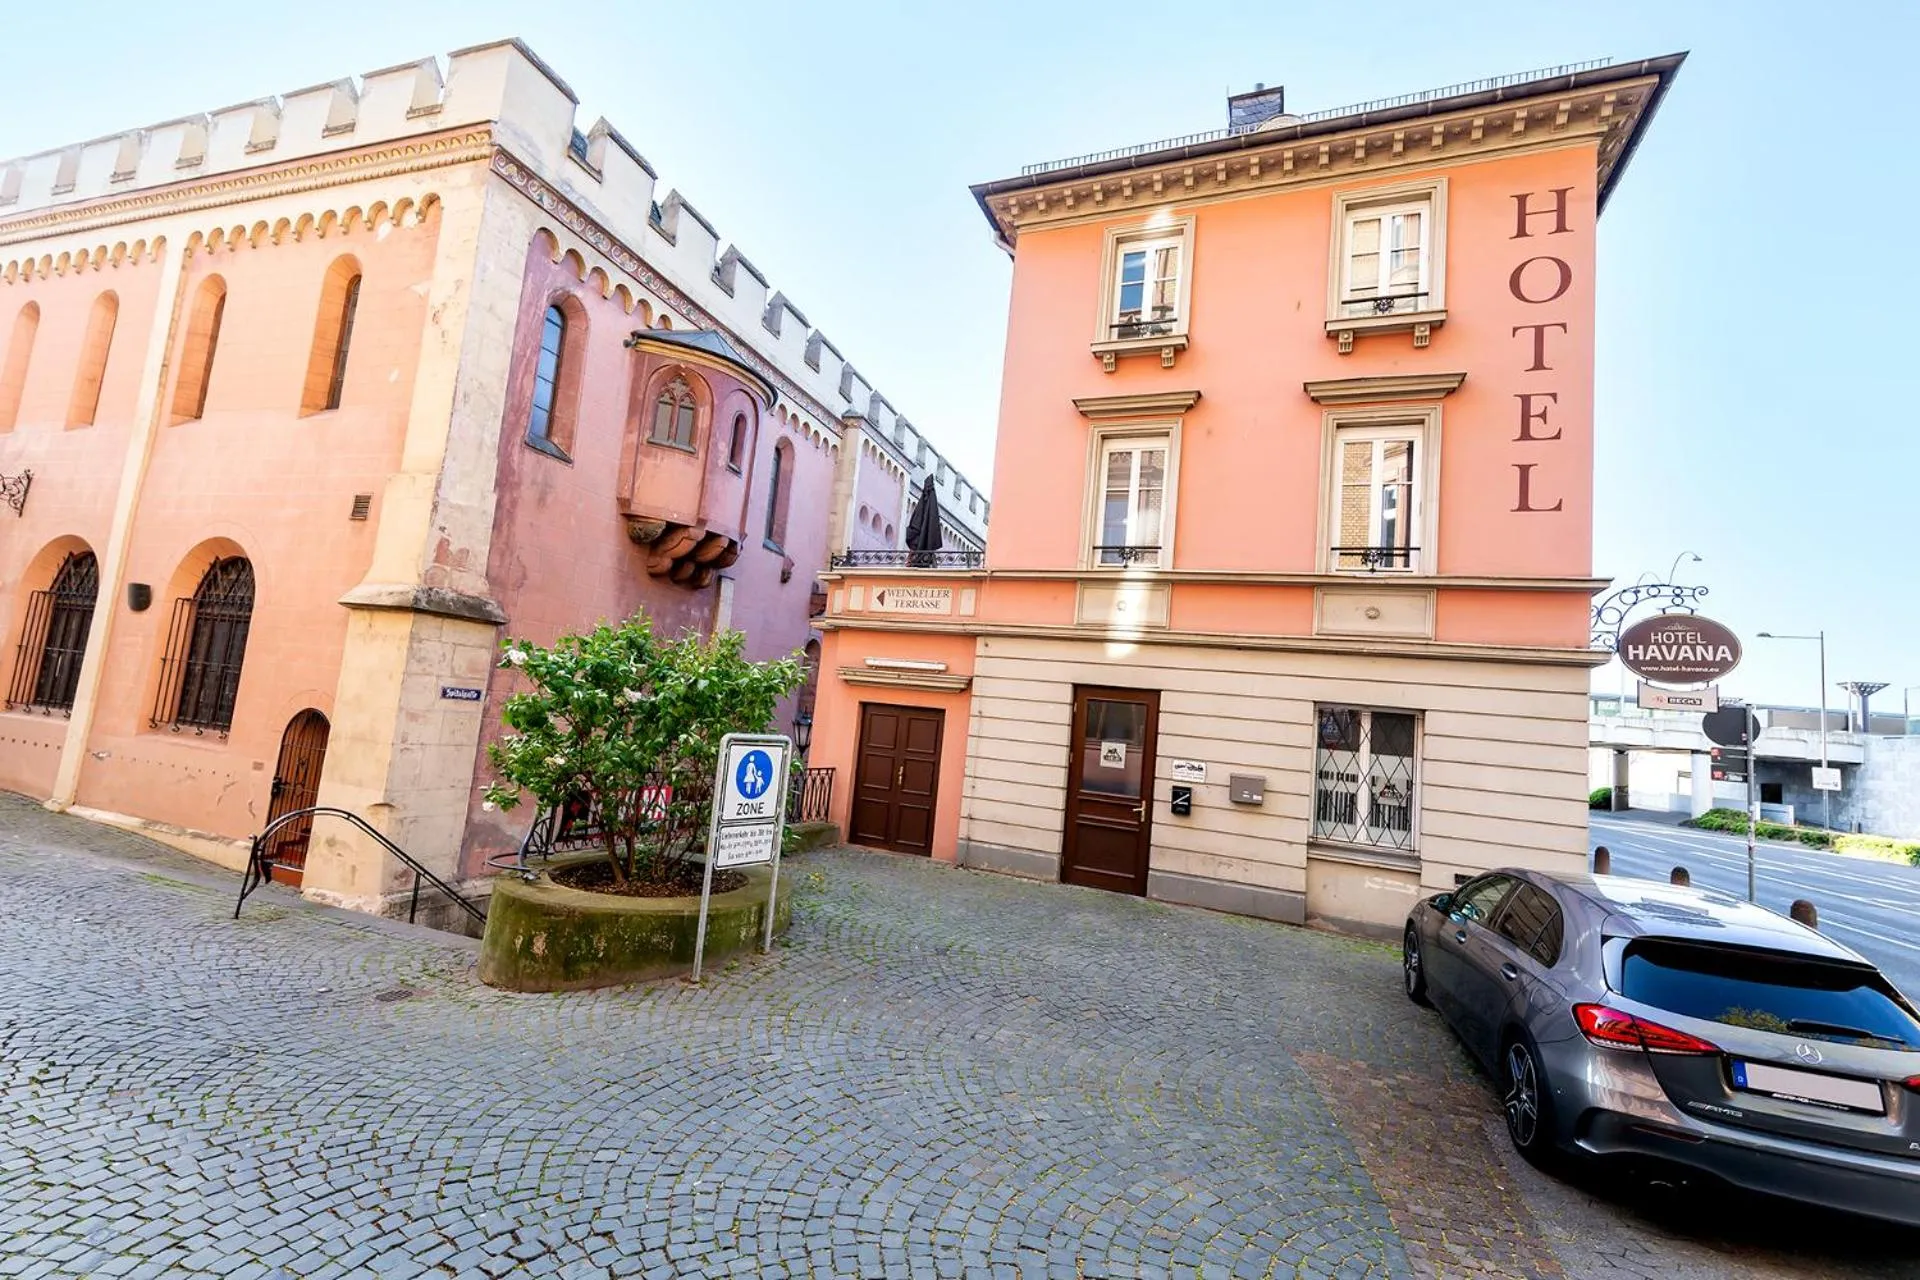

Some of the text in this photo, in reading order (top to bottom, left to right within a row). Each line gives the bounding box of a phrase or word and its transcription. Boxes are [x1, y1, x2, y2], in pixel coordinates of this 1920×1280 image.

[1508, 186, 1576, 513] HOTEL
[886, 588, 950, 599] WEINKELLER
[895, 599, 941, 609] TERRASSE
[1650, 631, 1707, 645] HOTEL
[1627, 644, 1733, 662] HAVANA
[736, 802, 765, 816] ZONE
